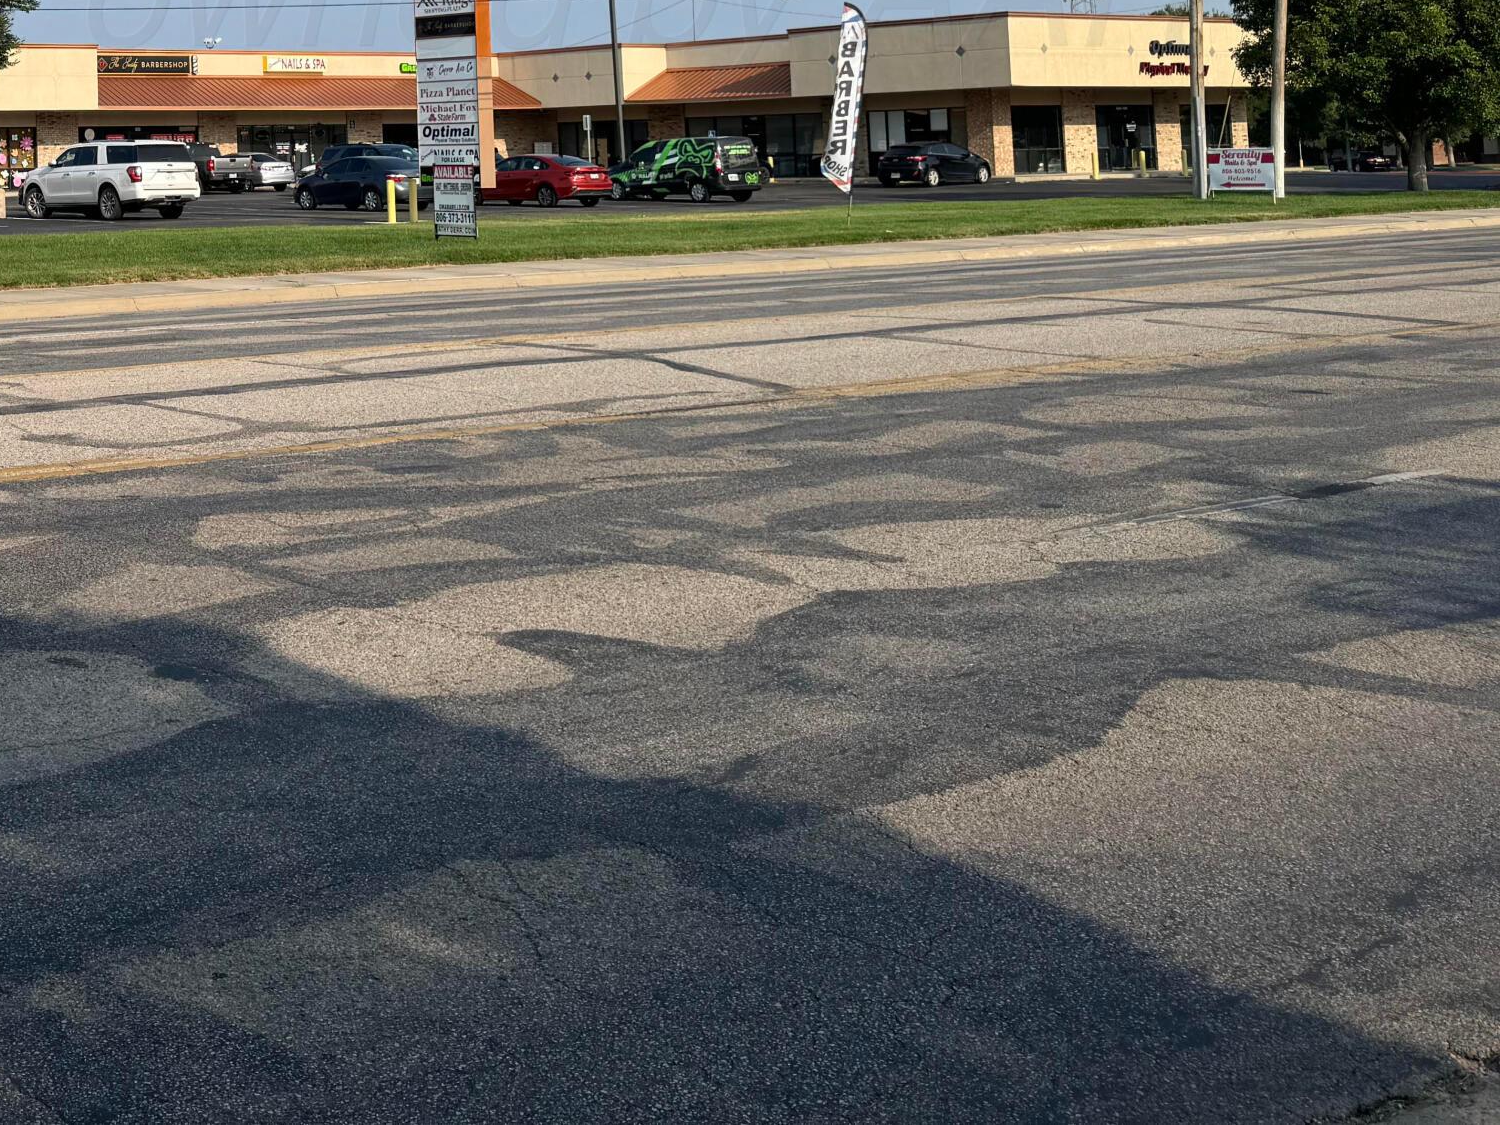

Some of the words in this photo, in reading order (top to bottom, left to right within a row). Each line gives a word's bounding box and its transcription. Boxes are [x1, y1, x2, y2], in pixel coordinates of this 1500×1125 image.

[281, 58, 303, 69] NAILS
[304, 59, 310, 69] &
[312, 58, 326, 69] SPA
[420, 88, 443, 98] Pizza
[446, 86, 475, 96] Planet
[420, 104, 457, 114] Michael
[459, 103, 477, 112] Fox
[422, 124, 475, 140] Optimal
[1221, 150, 1261, 161] Serenity
[1246, 159, 1258, 167] Spa
[434, 165, 473, 178] AVAILABLE
[435, 212, 475, 223] 806-373-3111
